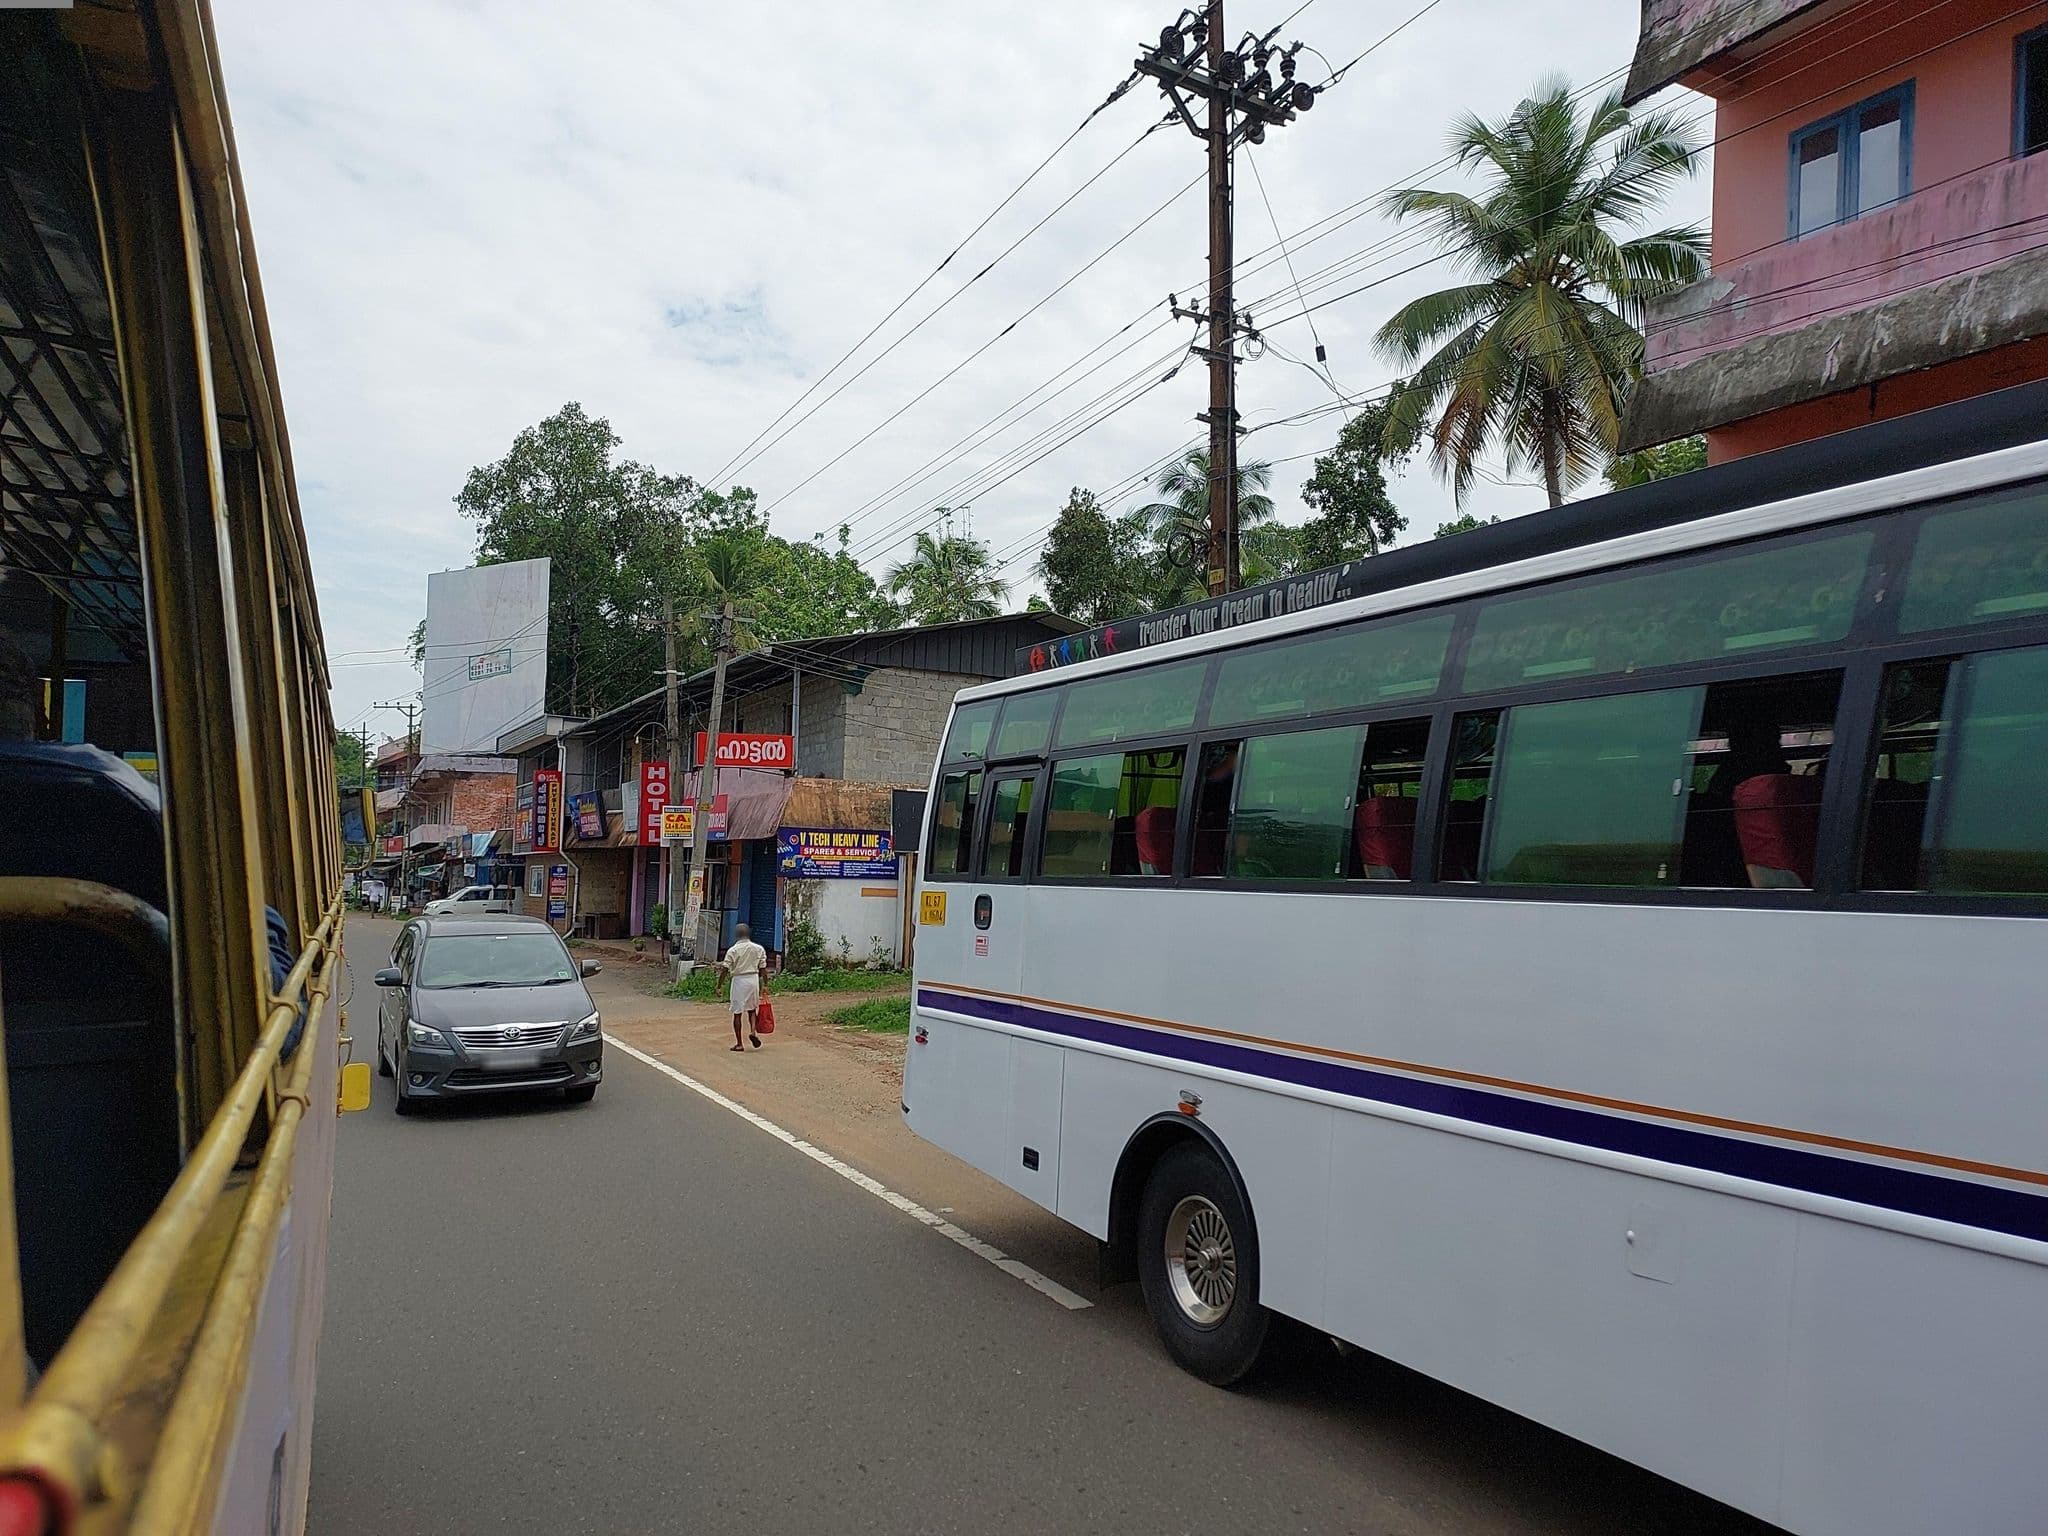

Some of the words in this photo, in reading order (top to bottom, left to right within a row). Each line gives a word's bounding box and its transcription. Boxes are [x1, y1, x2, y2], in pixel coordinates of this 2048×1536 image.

[1139, 614, 1187, 647] Transfer
[1189, 607, 1218, 635] Your
[1221, 593, 1264, 628] Dream
[1269, 588, 1283, 617] To
[715, 738, 786, 763] ഹാട്ടൽ
[646, 766, 666, 843] HOTEL
[800, 831, 807, 846] V
[808, 832, 831, 847] TECH
[833, 833, 860, 847] HEAVY
[861, 834, 879, 848] LINE
[803, 847, 835, 855] SPARES
[836, 848, 843, 856] &
[844, 848, 877, 857] SERVICE
